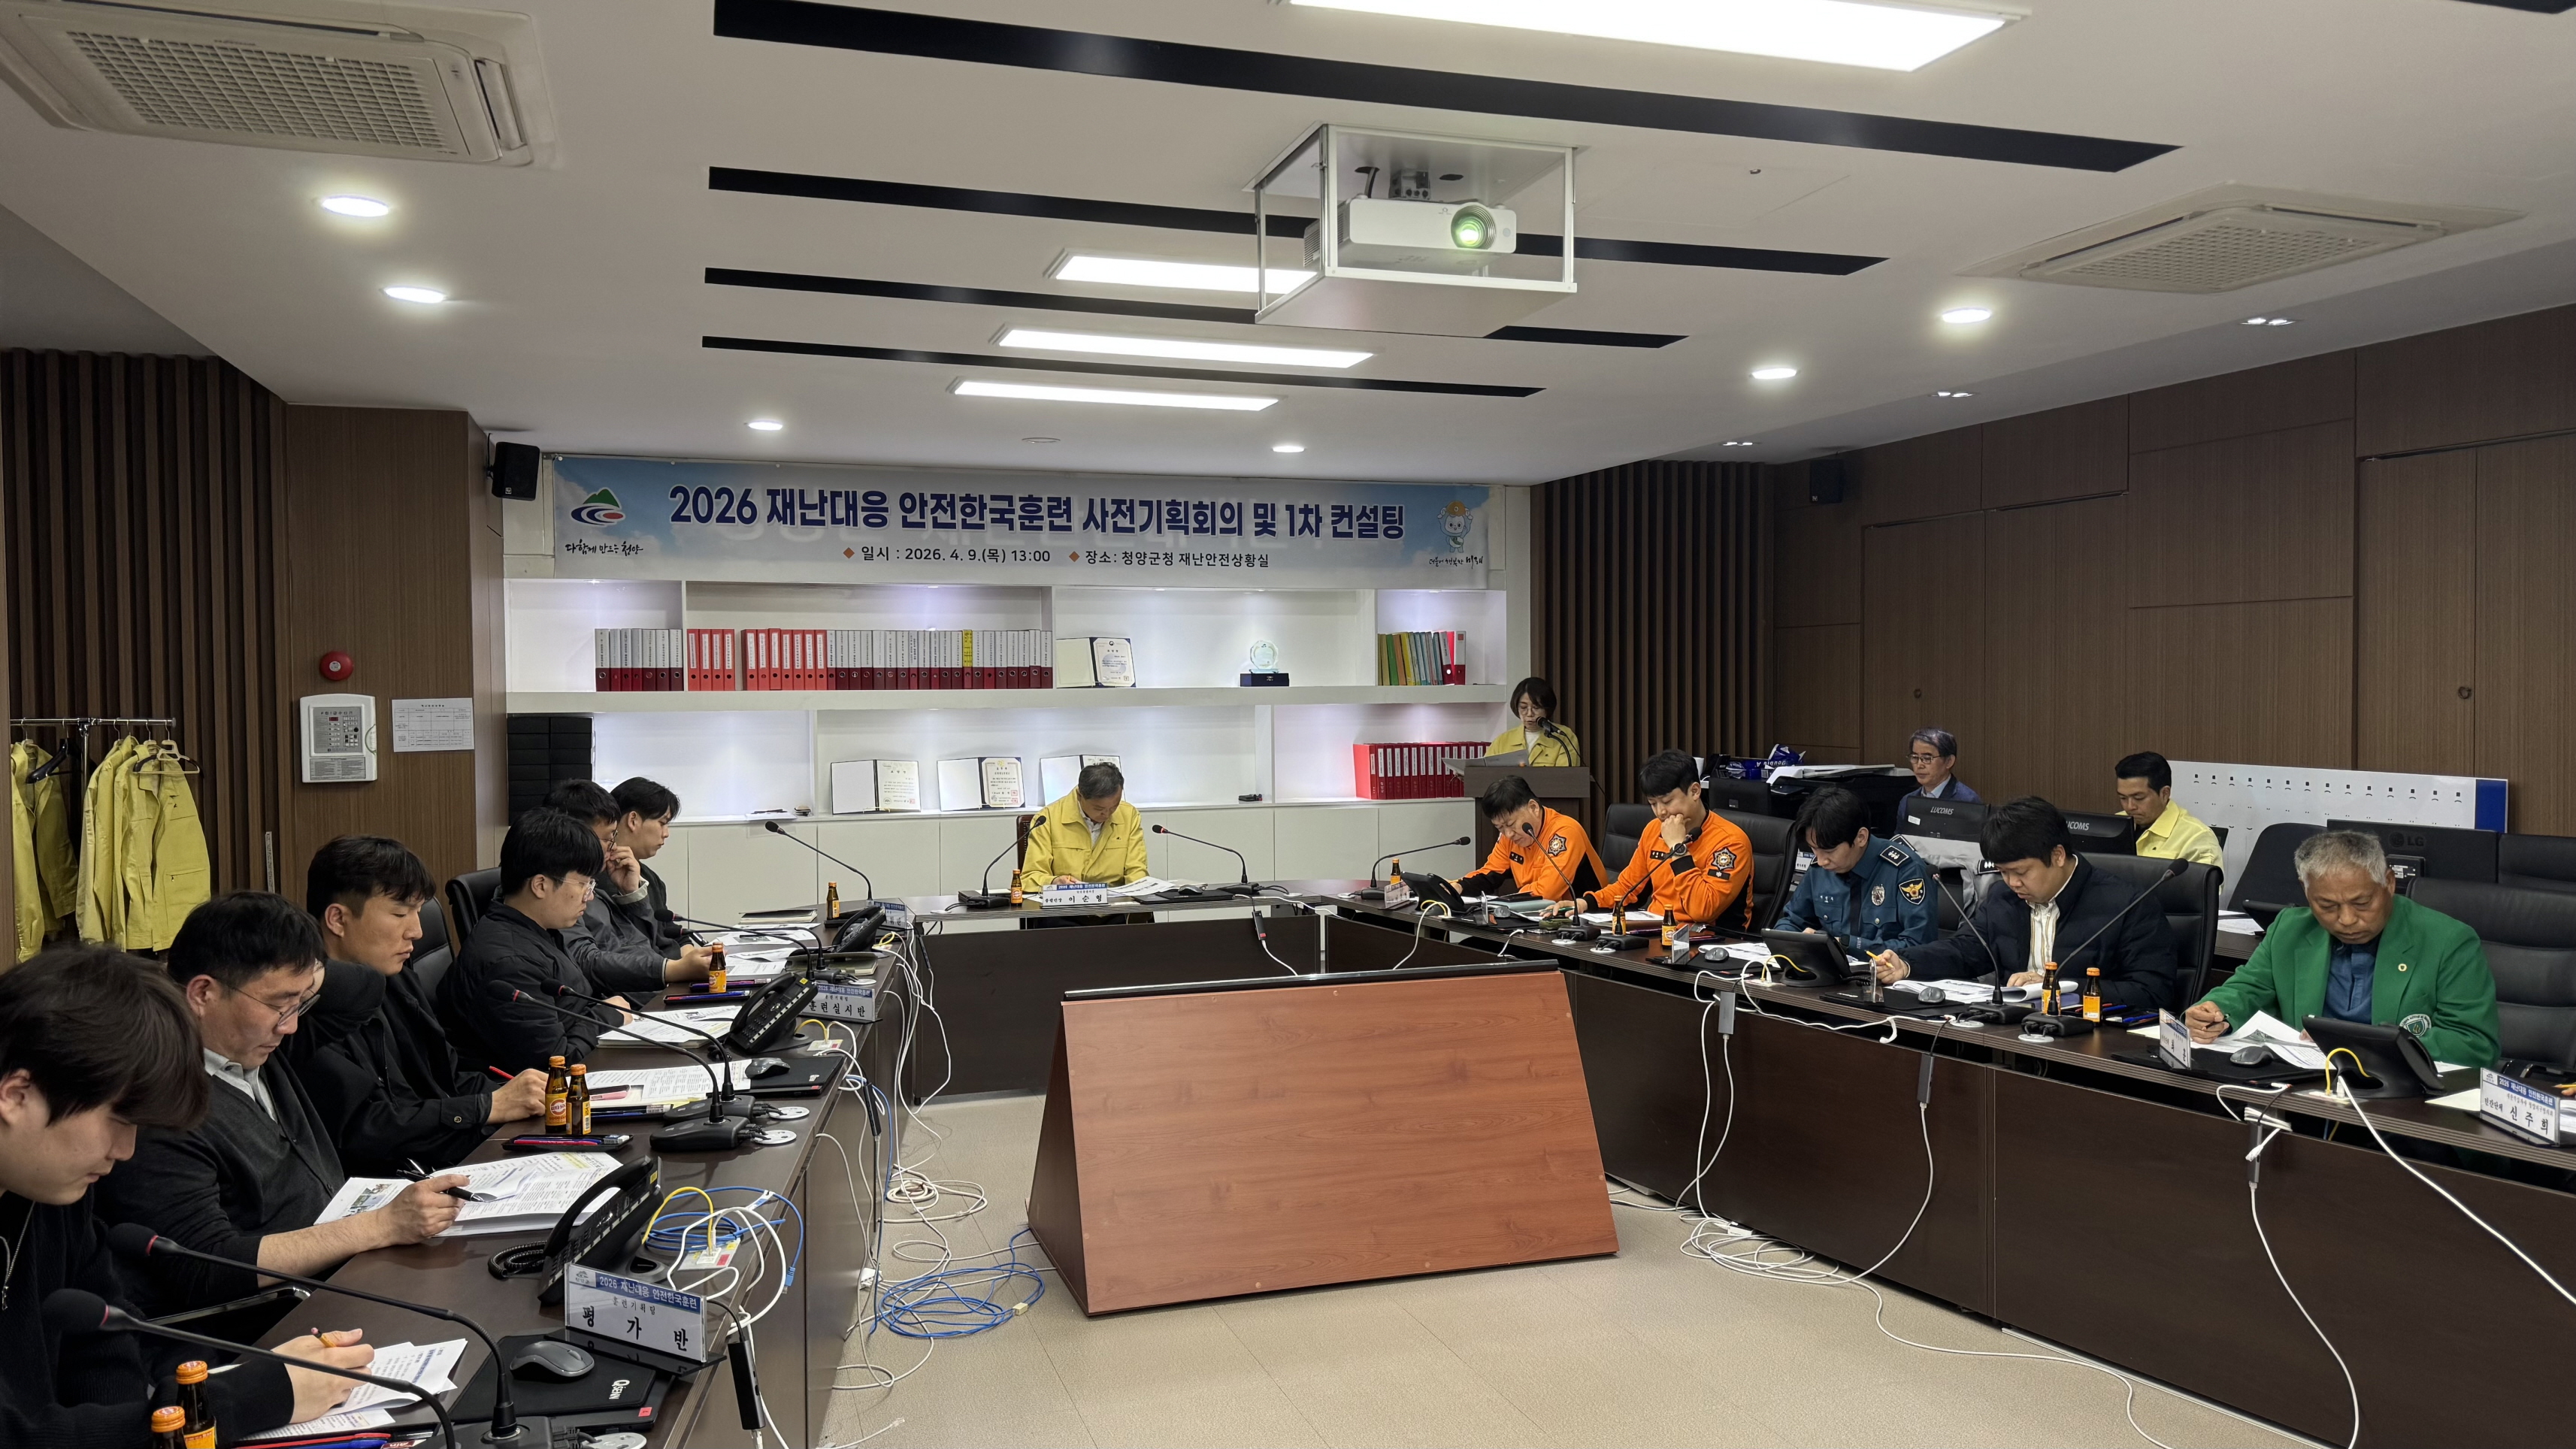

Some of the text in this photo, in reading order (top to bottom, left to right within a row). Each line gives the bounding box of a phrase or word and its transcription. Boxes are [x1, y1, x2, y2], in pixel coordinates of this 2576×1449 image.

[670, 485, 1404, 540] 2026 재난대응 안전한국훈련 사전기획회의 및 1차 컨설팅
[861, 546, 890, 562] 일시
[905, 547, 946, 561] 2026.
[949, 548, 964, 561] 4.
[968, 547, 1006, 564] 9.(목)
[1011, 548, 1050, 562] 13:00
[1085, 550, 1270, 568] 장소: 청양군청 재난안전상황실
[1930, 806, 1954, 815] LUCOMS
[2407, 835, 2424, 847] LG
[599, 1276, 618, 1290] 2026
[620, 1281, 649, 1298] 재난대응
[652, 1288, 698, 1309] 안전한국훈련
